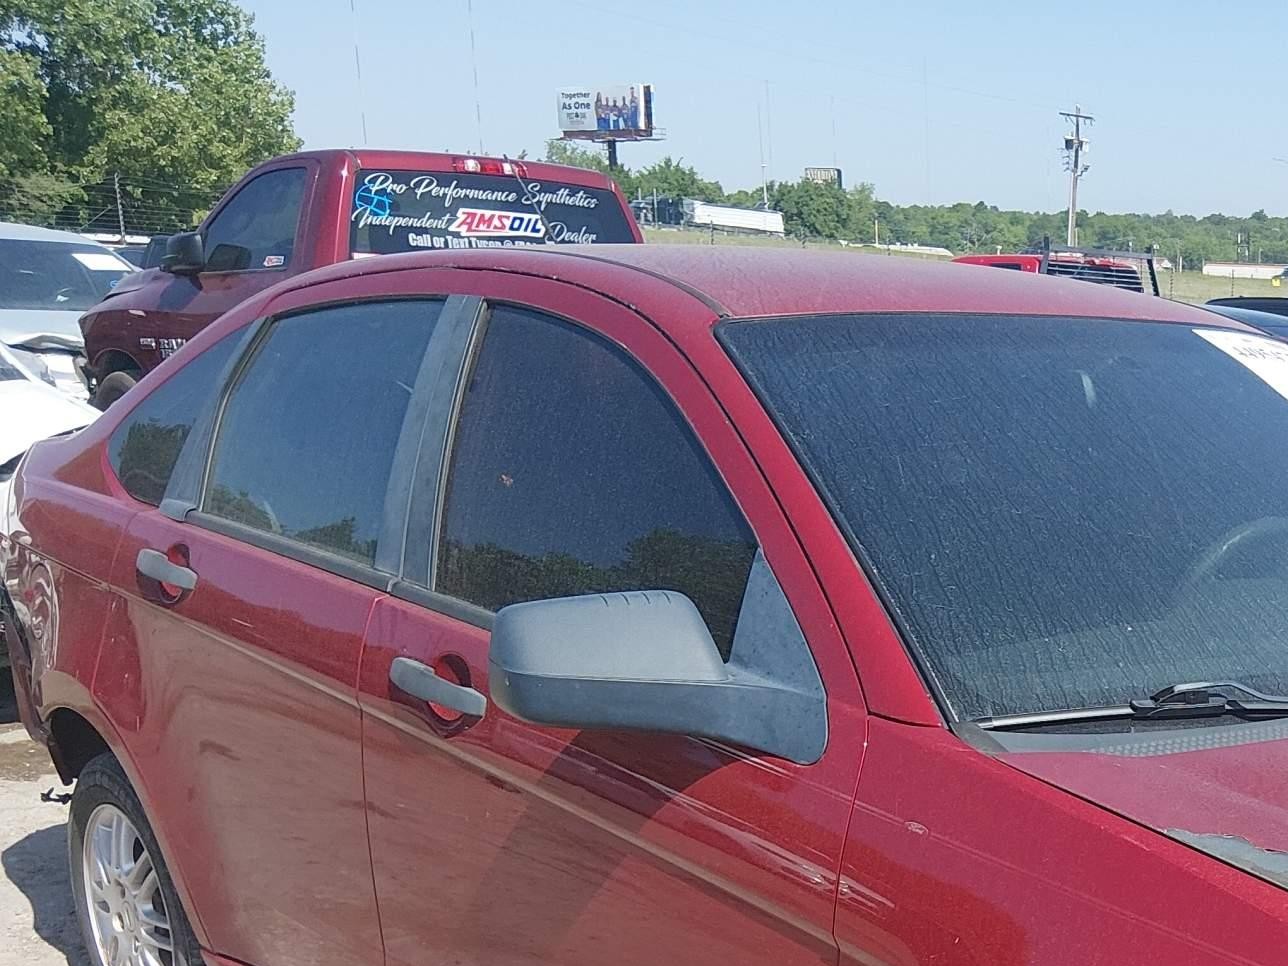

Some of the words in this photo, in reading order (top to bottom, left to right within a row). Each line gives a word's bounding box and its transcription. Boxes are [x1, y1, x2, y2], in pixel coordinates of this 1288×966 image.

[561, 92, 591, 100] Together
[562, 102, 572, 110] As
[574, 101, 591, 110] One
[364, 172, 409, 196] Pro
[410, 175, 517, 207] Performance
[521, 182, 599, 211] Synthetics
[351, 206, 457, 235] Independent
[455, 211, 543, 233] AMSOIL
[544, 221, 597, 244] Dealer
[408, 232, 432, 248] Call
[432, 236, 445, 249] or
